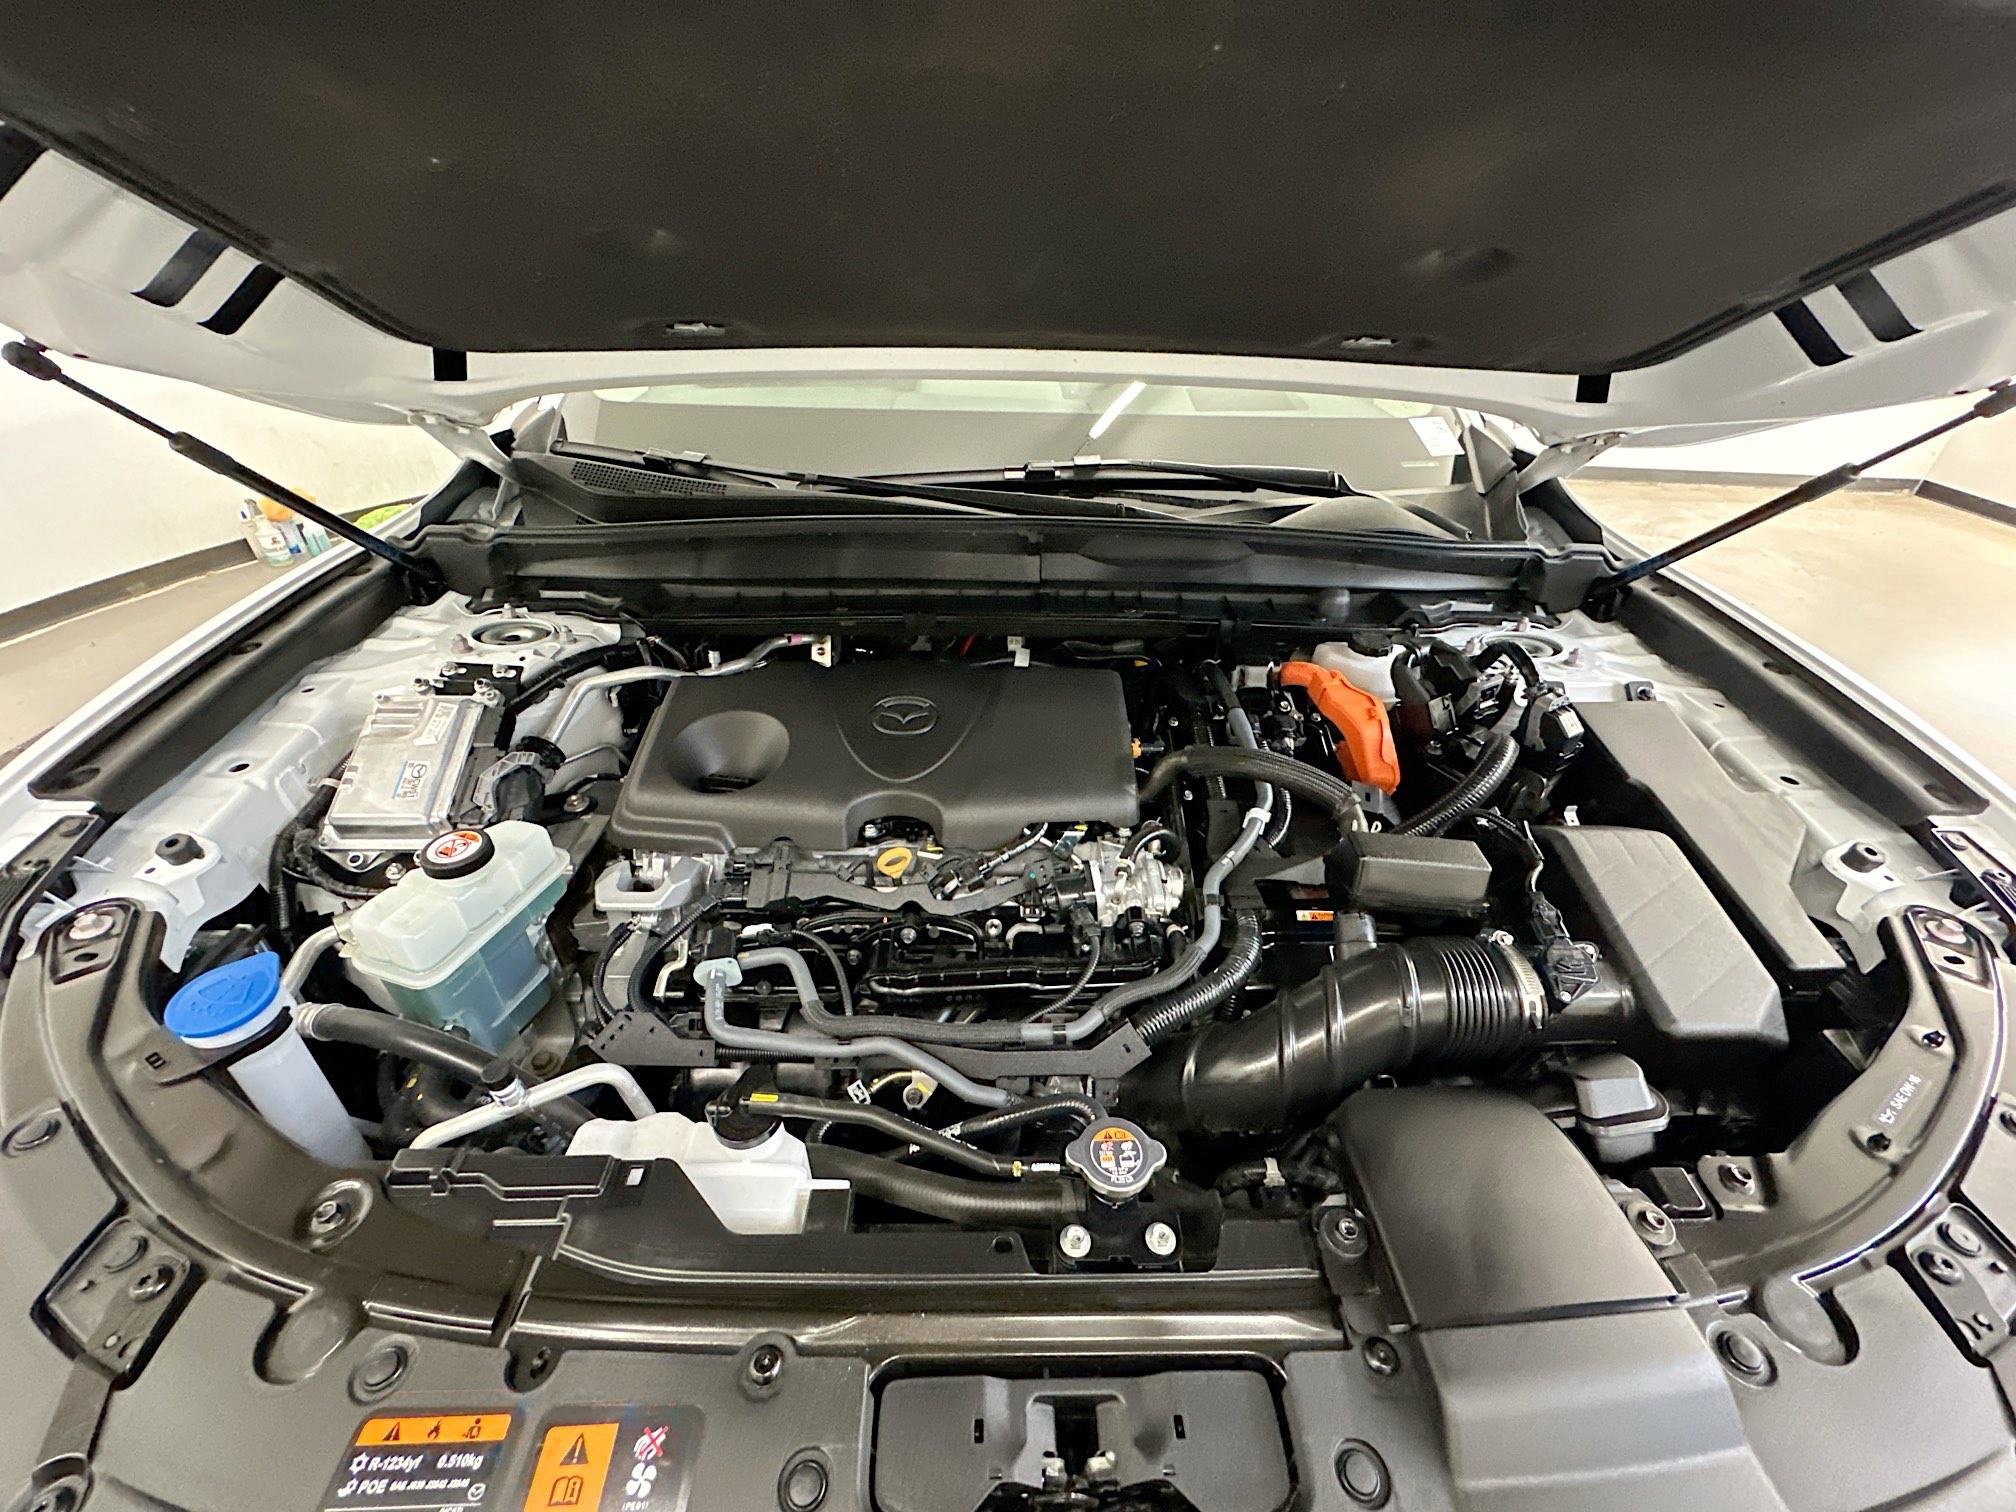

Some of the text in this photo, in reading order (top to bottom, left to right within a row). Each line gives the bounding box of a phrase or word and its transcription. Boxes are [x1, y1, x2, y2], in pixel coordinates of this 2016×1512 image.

[367, 1452, 484, 1473] R-1234yf 0.510kg
[357, 1479, 389, 1495] POE
